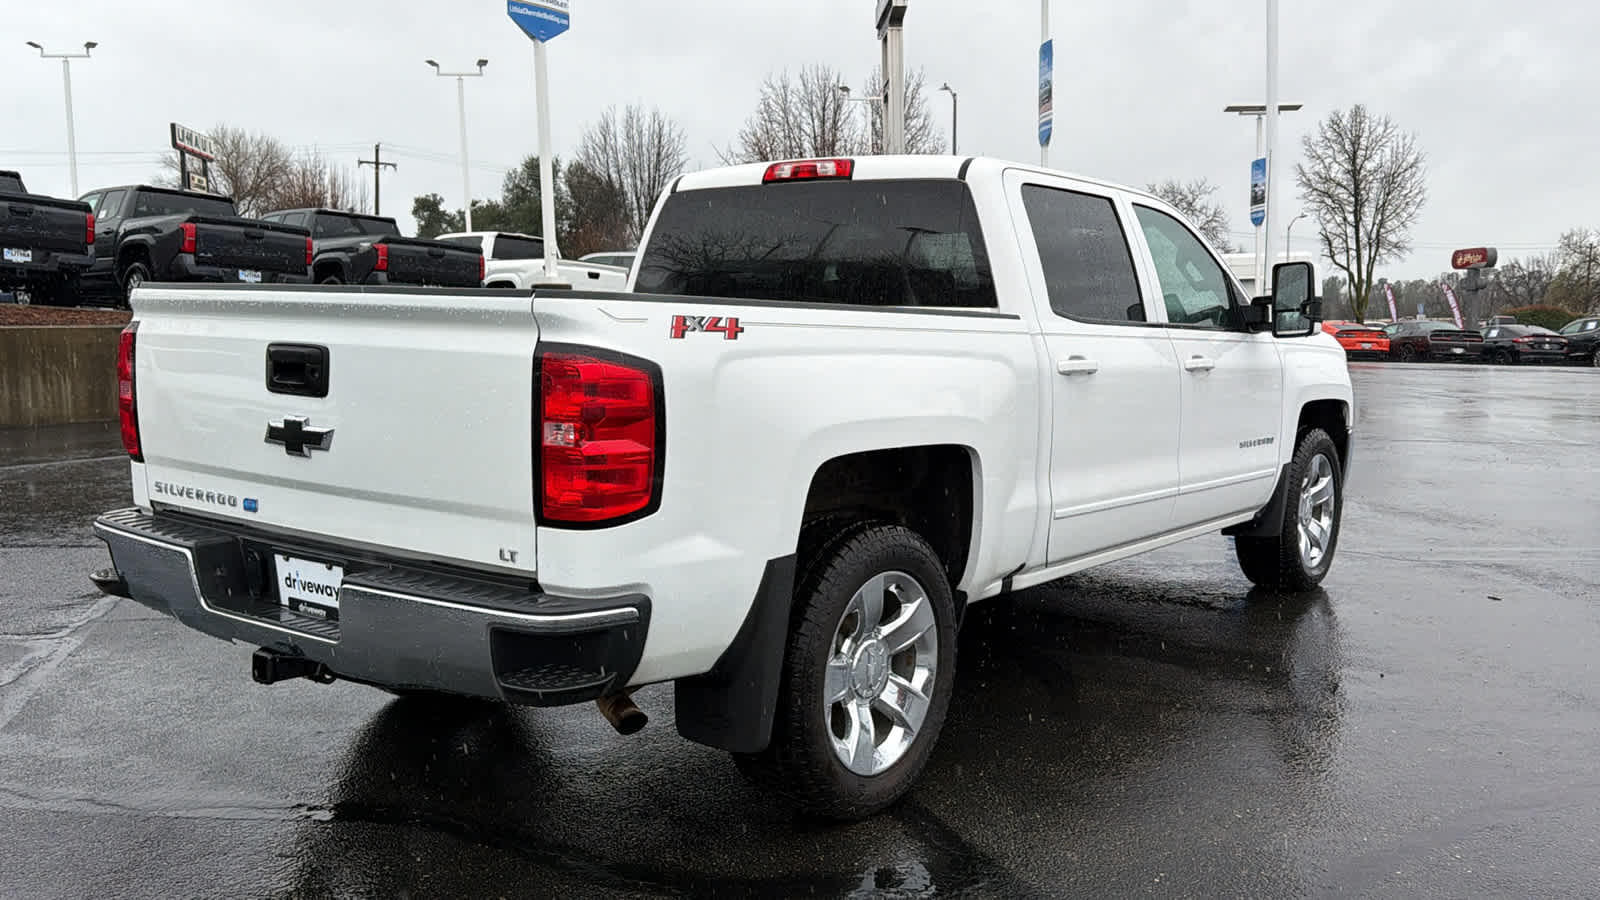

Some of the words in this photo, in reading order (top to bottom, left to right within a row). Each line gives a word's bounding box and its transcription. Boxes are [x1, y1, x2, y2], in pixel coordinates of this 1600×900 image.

[154, 480, 238, 507] SILVERADO
[499, 548, 519, 564] LT
[284, 569, 340, 601] driveway
